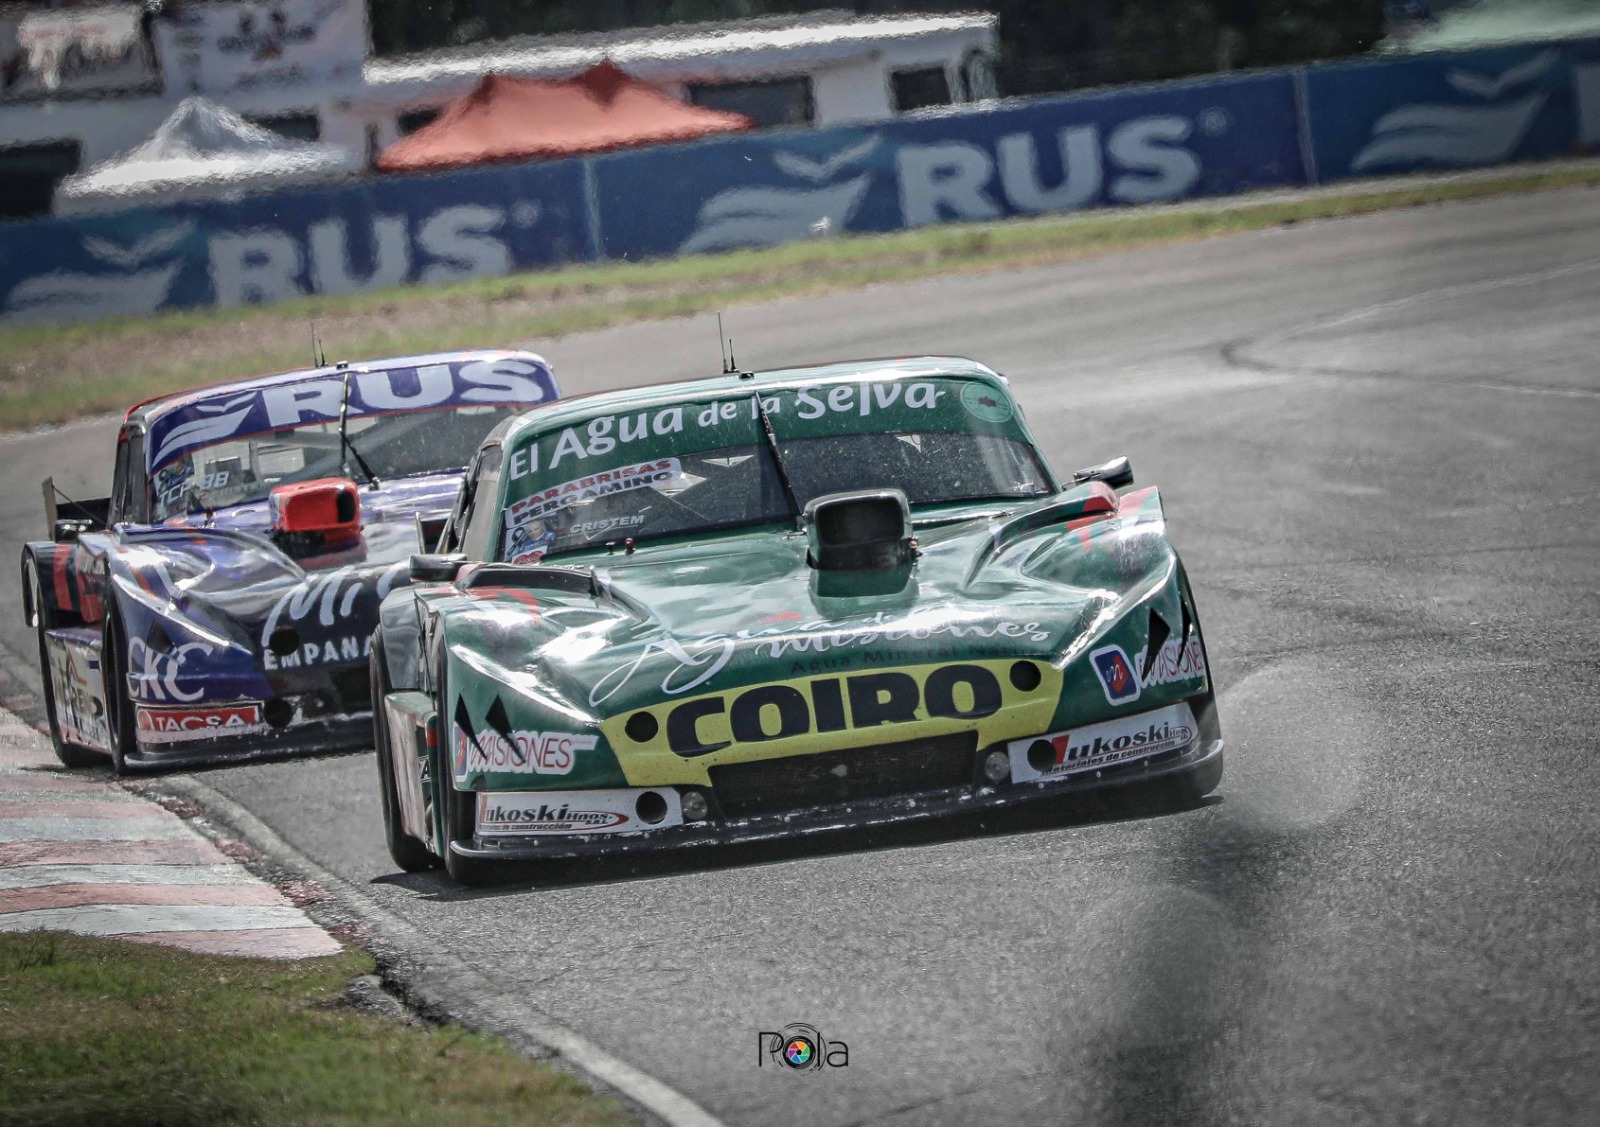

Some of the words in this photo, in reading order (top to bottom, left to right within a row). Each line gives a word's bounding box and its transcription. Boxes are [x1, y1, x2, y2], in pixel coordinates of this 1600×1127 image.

[898, 115, 1200, 226] RUS
[207, 205, 512, 308] RUS
[262, 360, 544, 427] RUS
[510, 443, 539, 481] El
[549, 407, 683, 470] Agua
[698, 401, 737, 428] de
[795, 382, 946, 419] Selva
[511, 459, 672, 515] PARABRISAS
[514, 471, 674, 525] PERGAMINO
[569, 514, 645, 534] CRISTEM
[156, 713, 246, 732] TACSA
[666, 664, 1003, 758] COIRO
